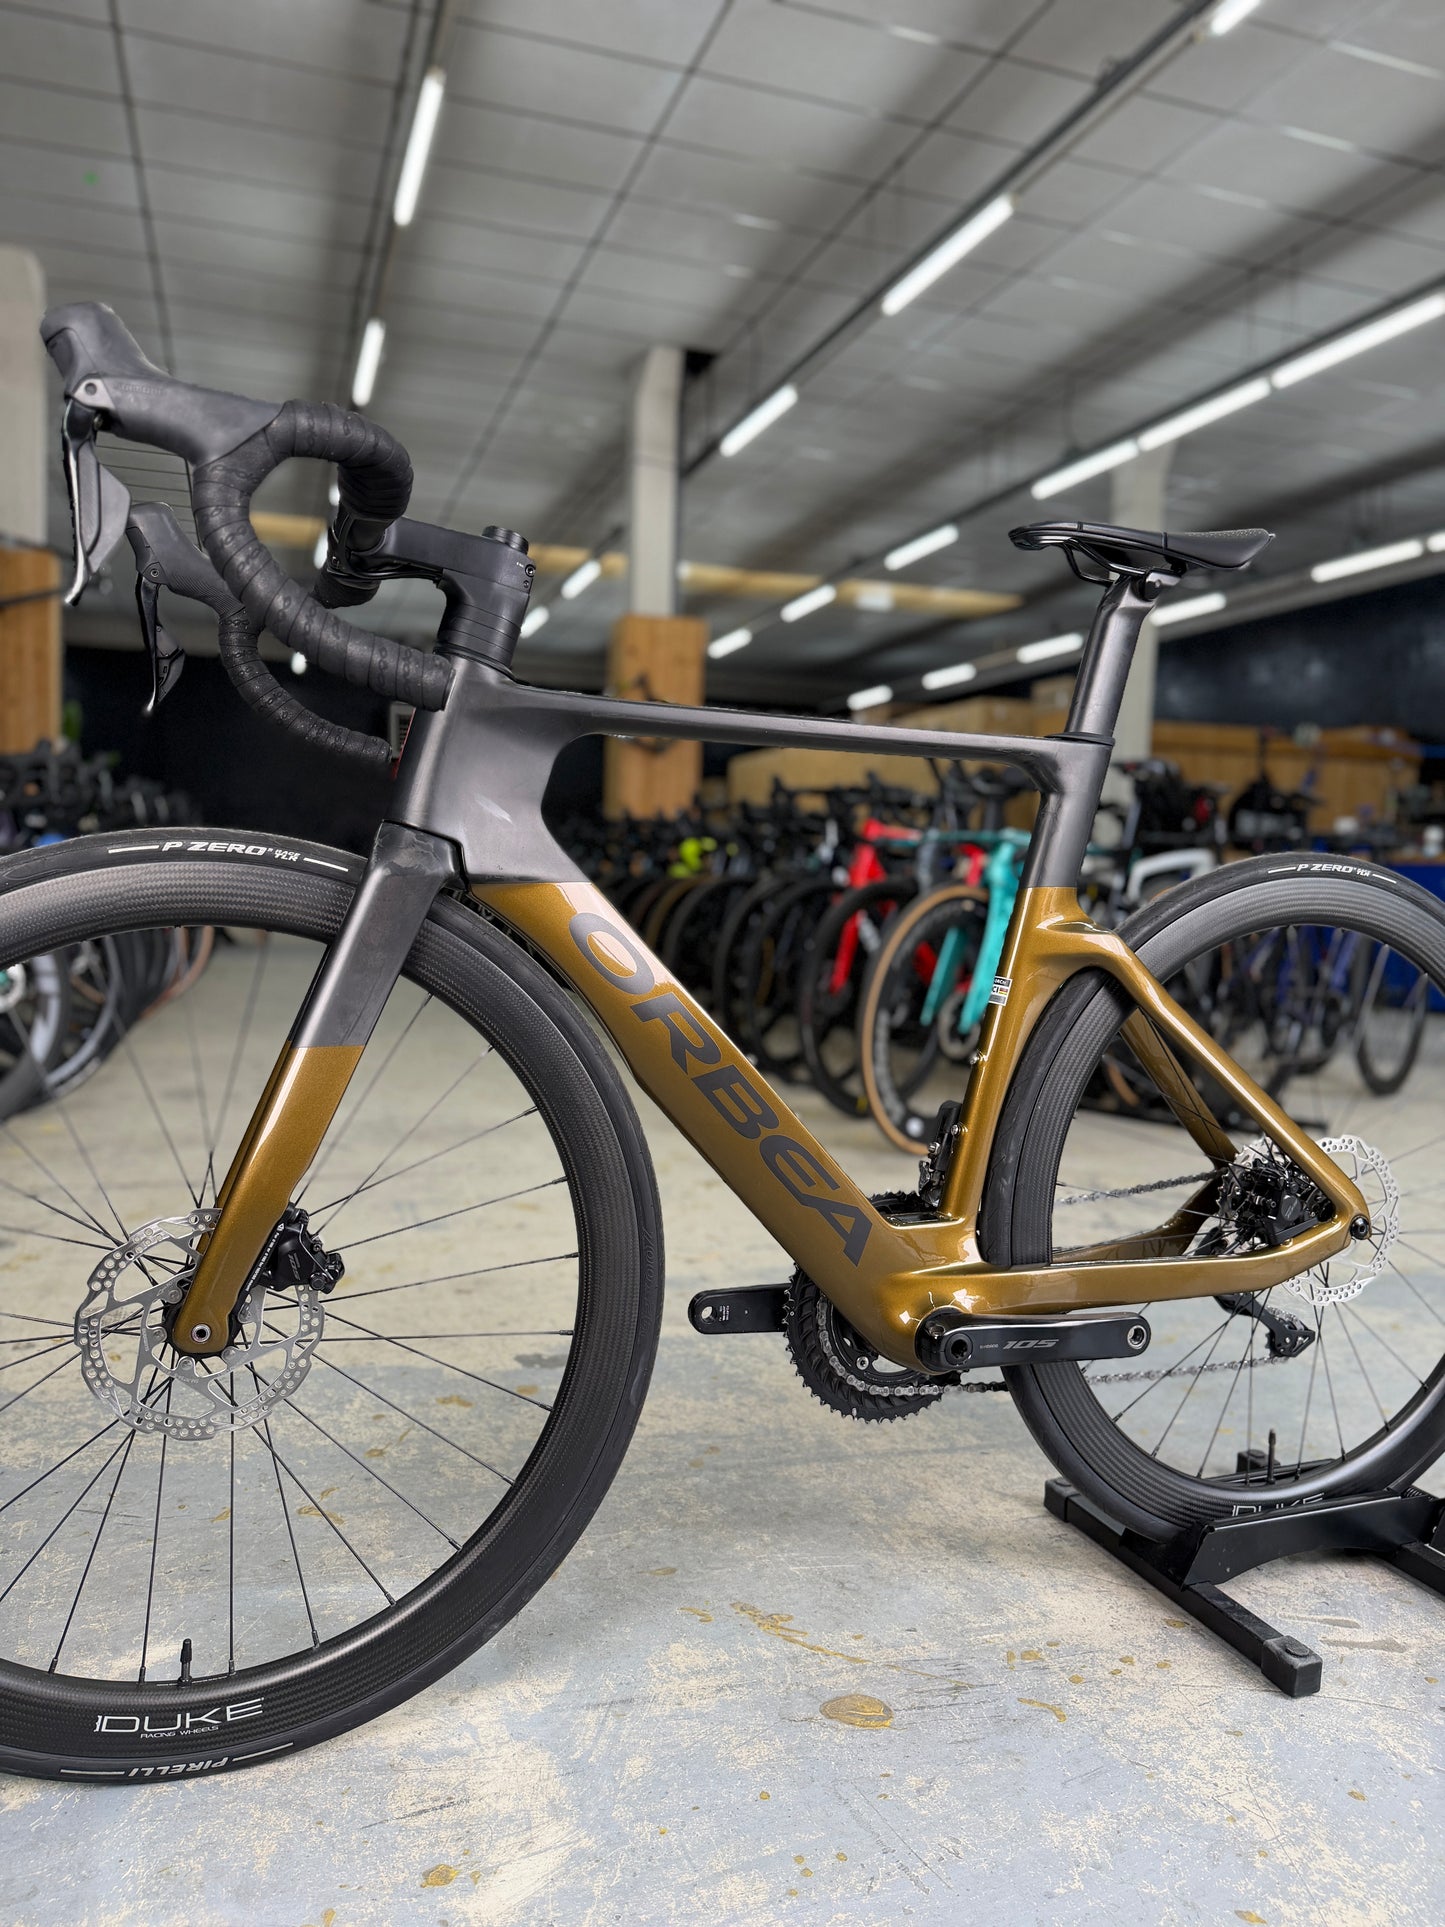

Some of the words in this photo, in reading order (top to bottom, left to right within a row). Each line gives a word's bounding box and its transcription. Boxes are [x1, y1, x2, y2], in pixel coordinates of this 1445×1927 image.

[162, 841, 183, 852] P
[1297, 863, 1309, 872] P
[568, 912, 874, 1268] ORBEA
[1002, 1338, 1060, 1350] 105
[94, 1697, 265, 1733] DUKE
[140, 1731, 176, 1739] RACING
[180, 1725, 219, 1736] WHEELS
[128, 1756, 229, 1777] PIRELLI
